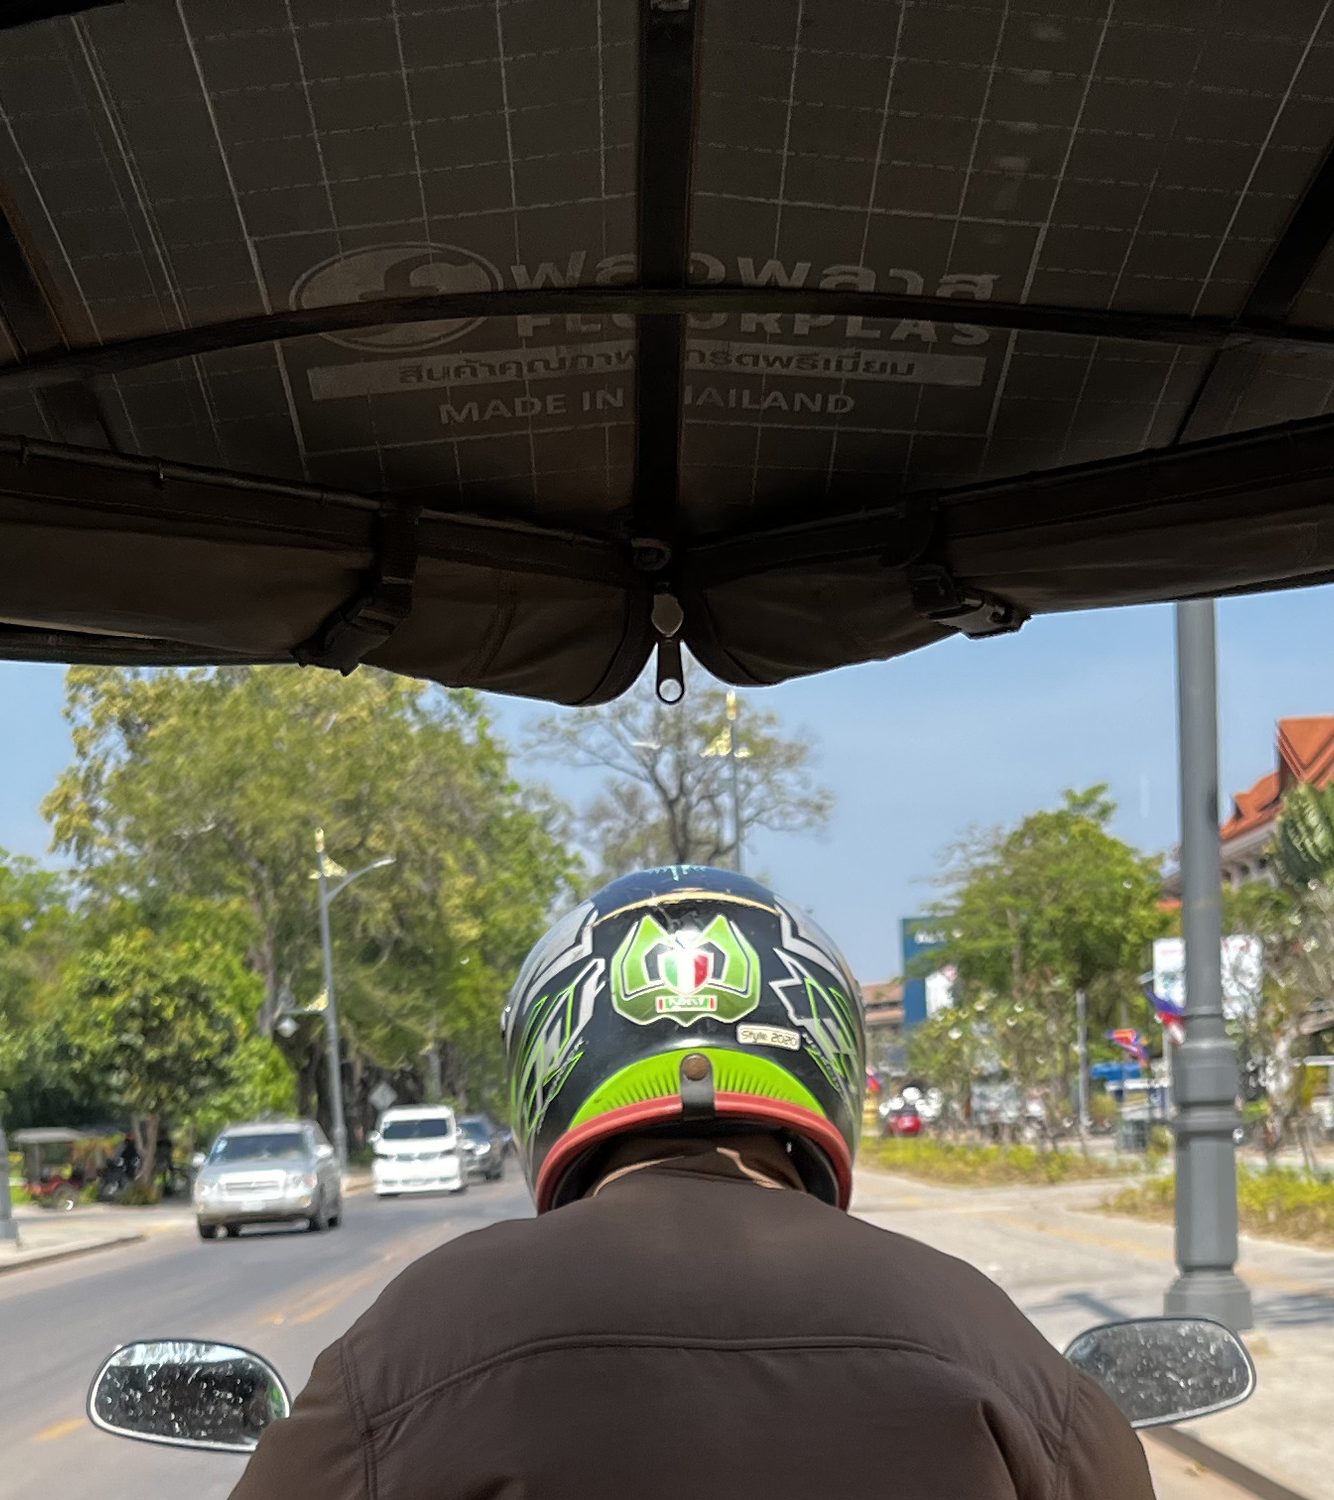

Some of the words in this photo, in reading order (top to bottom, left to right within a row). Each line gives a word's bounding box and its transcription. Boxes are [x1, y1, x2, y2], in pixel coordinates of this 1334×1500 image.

[438, 393, 567, 425] MADE
[582, 388, 624, 412] IN
[684, 385, 856, 414] AILAND
[741, 1030, 767, 1044] Style
[770, 1032, 798, 1047] 2020
